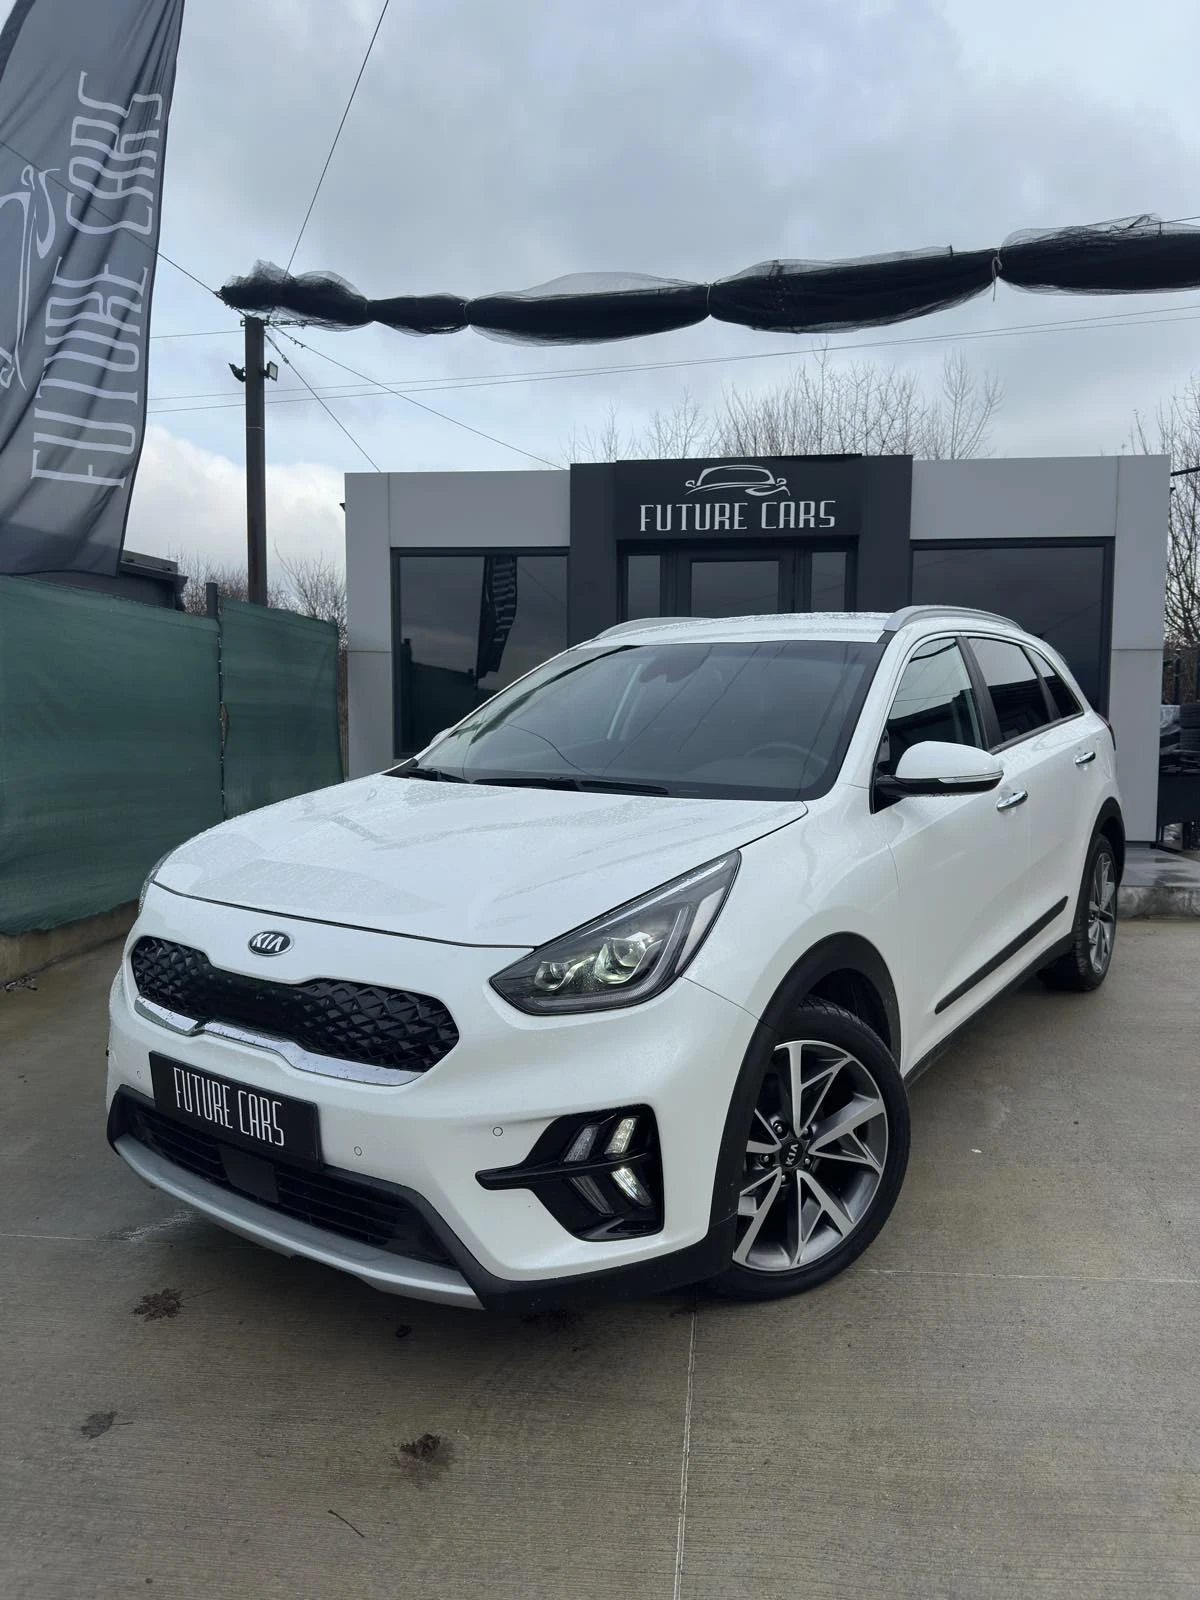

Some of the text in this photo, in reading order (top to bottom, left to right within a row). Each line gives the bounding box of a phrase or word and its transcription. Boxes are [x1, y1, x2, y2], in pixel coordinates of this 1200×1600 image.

[30, 70, 163, 489] FUTURE CARS
[639, 500, 836, 532] FUTURE CARS
[251, 932, 285, 952] KIA
[173, 1067, 285, 1147] FUTURE CARS
[785, 1143, 799, 1166] KIA
